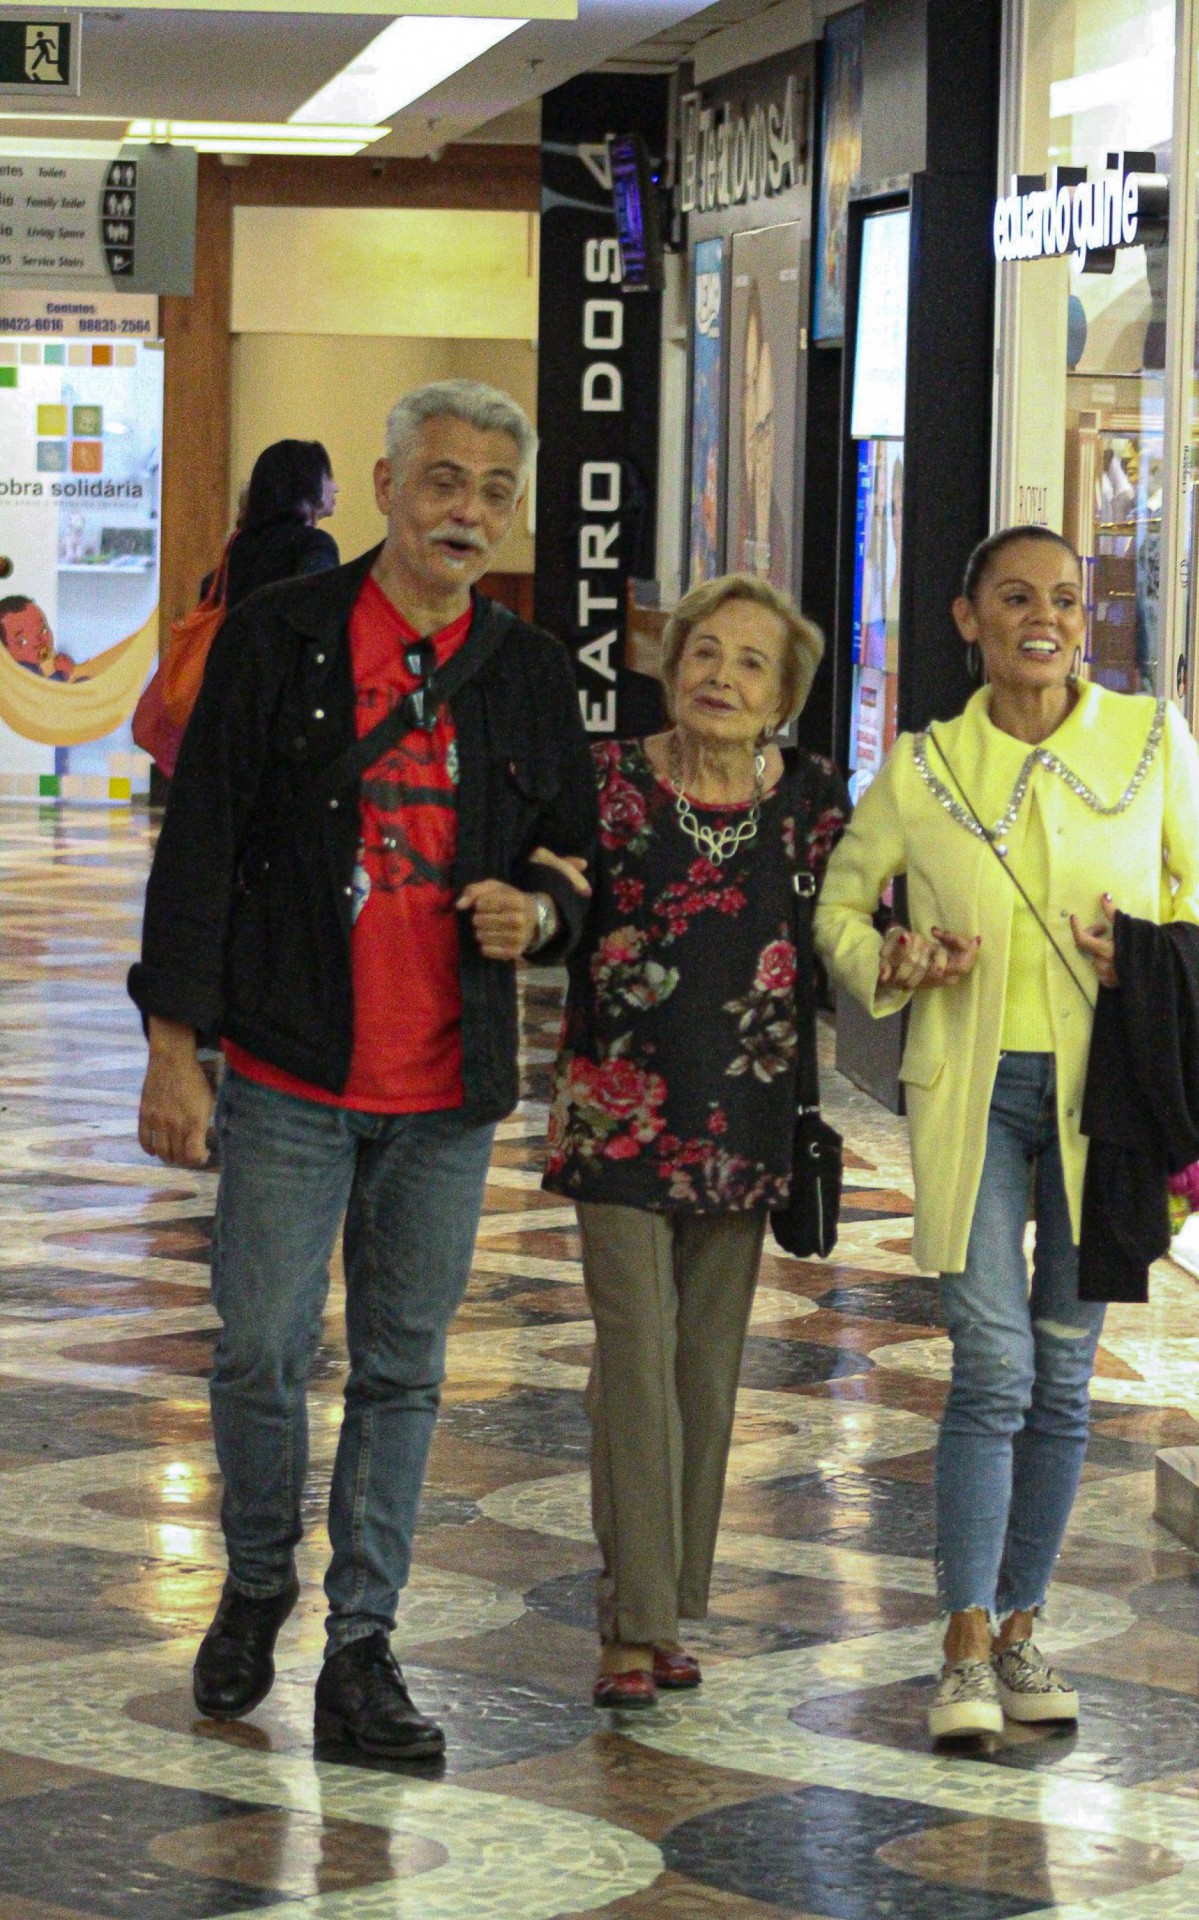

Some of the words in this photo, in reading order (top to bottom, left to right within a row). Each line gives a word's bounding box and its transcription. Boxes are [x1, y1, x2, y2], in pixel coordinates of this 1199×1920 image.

[38, 167, 67, 178] Toilets
[26, 195, 57, 210] Family
[61, 197, 86, 208] Toilet
[27, 227, 55, 240] Living
[59, 227, 85, 239] Space
[22, 255, 56, 266] Service
[59, 256, 84, 267] Stairs
[46, 302, 96, 314] Contatos
[581, 238, 624, 412] DOS
[51, 478, 143, 498] solidária
[577, 462, 621, 733] EATRO
